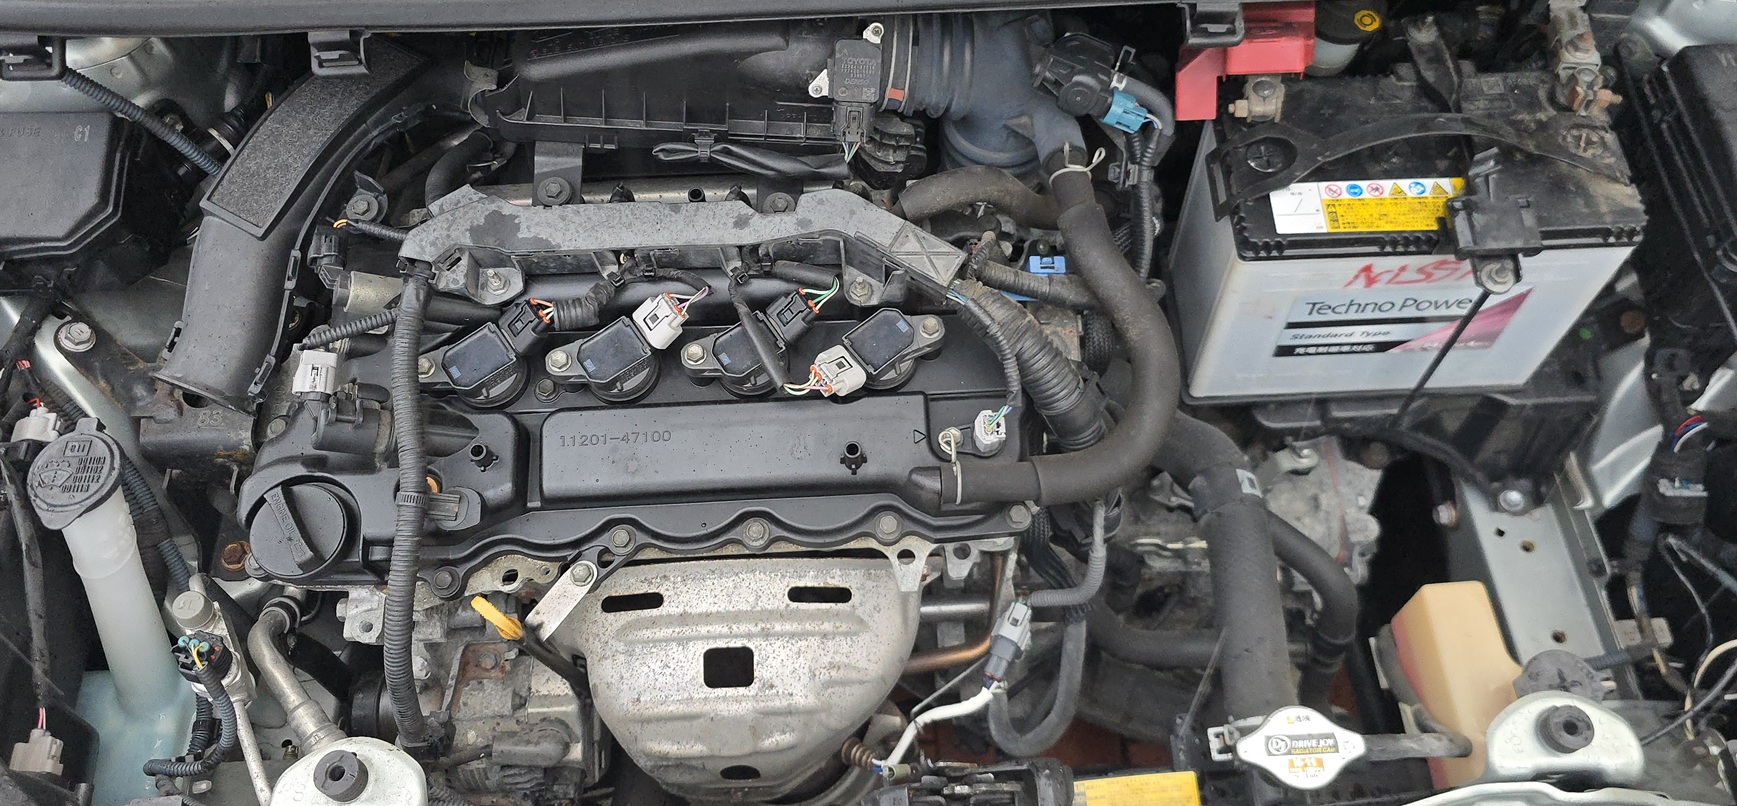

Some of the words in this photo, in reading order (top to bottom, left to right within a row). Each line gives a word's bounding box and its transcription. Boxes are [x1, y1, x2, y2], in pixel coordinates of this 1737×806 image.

[841, 57, 877, 66] TOYOTA
[1305, 299, 1394, 316] Techno
[1398, 298, 1474, 312] Powe
[1289, 331, 1355, 341] Standard
[1359, 330, 1392, 338] Type
[75, 465, 104, 475] 001102
[72, 475, 101, 484] 001112
[271, 492, 291, 524] ENGINE
